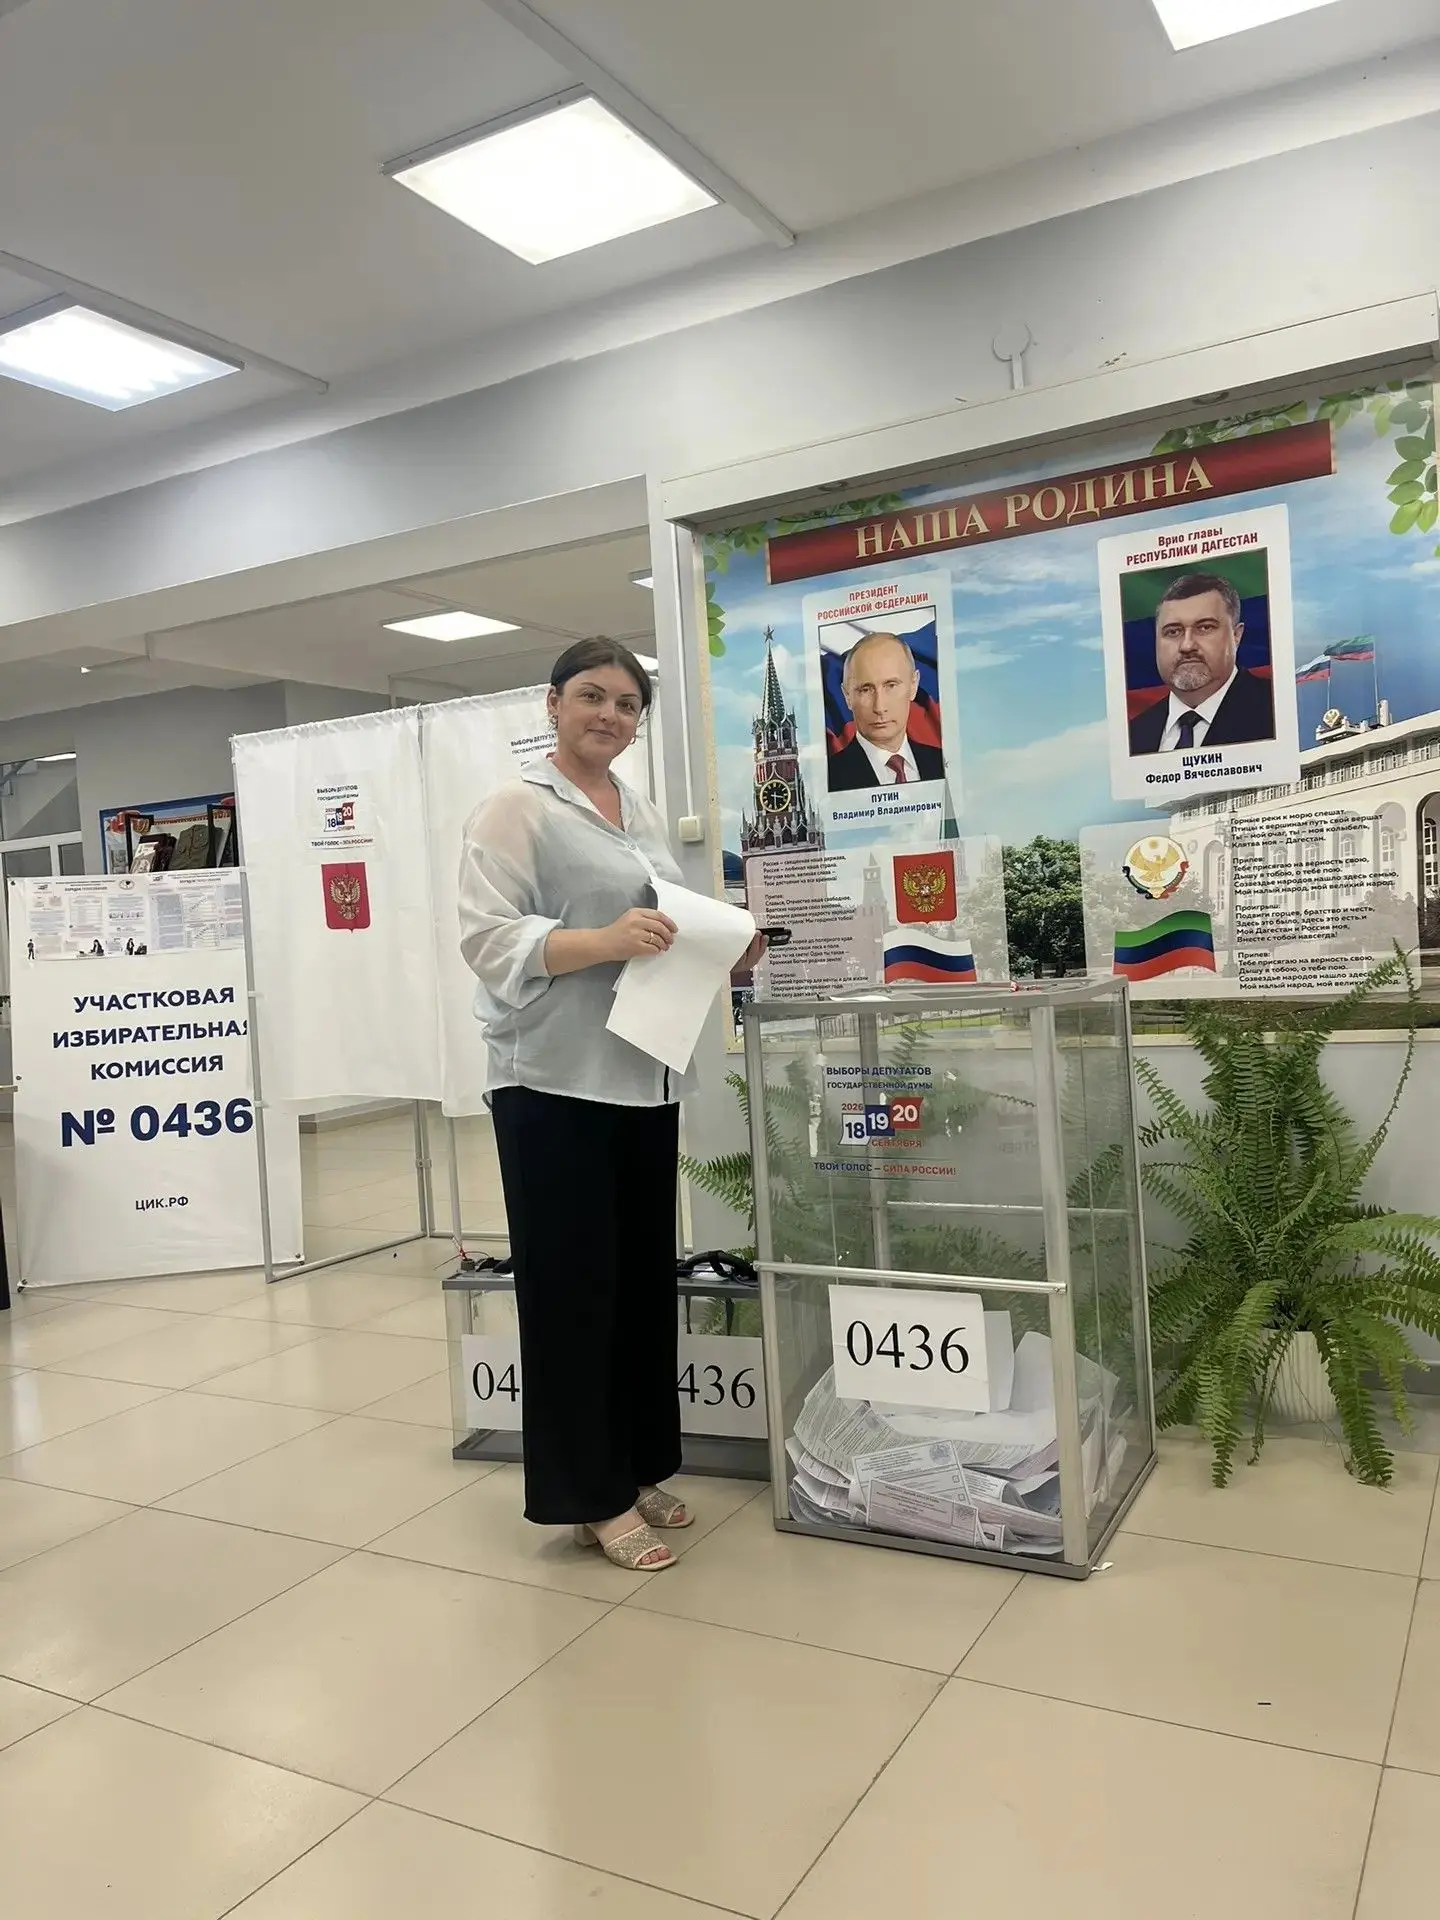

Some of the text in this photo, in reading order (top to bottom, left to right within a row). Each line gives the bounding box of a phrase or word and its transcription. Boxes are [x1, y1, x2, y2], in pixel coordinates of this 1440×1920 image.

[855, 457, 1213, 559] НАША РОДИНА
[1158, 528, 1222, 548] Врио главы
[1127, 532, 1258, 565] РЕСПУБЛИКИ ДАГЕСТАН
[849, 585, 898, 601] ПРЕЗИДЕНТ
[875, 593, 928, 610] ФЕДЕРАЦИИ
[1182, 753, 1222, 767] ЩУКИН
[1146, 764, 1262, 784] Федор Вячеславович
[871, 792, 899, 803] ПУТИН
[327, 818, 336, 827] 18
[342, 807, 352, 817] 20
[833, 801, 942, 820] Владимир Владимирович
[1352, 814, 1383, 822] вершат
[1304, 908, 1341, 916] братство
[1311, 956, 1348, 964] верность
[73, 987, 234, 1013] УЧАСТКОВАЯ
[91, 1055, 223, 1080] КОМИССИЯ
[826, 1067, 932, 1077] ВЫБОРЫ ДЕПУТАТОВ
[827, 1081, 907, 1089] ГОСУДАРСТВЕННОЙ
[842, 1103, 864, 1111] 2026
[61, 1098, 253, 1147] № 0436
[845, 1105, 918, 1139] 18 19 20
[872, 1139, 922, 1148] СЕНТЯБРЯ
[841, 1163, 872, 1172] ГОЛОС
[912, 1165, 956, 1176] РОССИИ!
[136, 1196, 188, 1211] ЦИК.РФ
[847, 1320, 969, 1373] 0436
[472, 1362, 520, 1402] 04
[677, 1363, 755, 1408] 436
